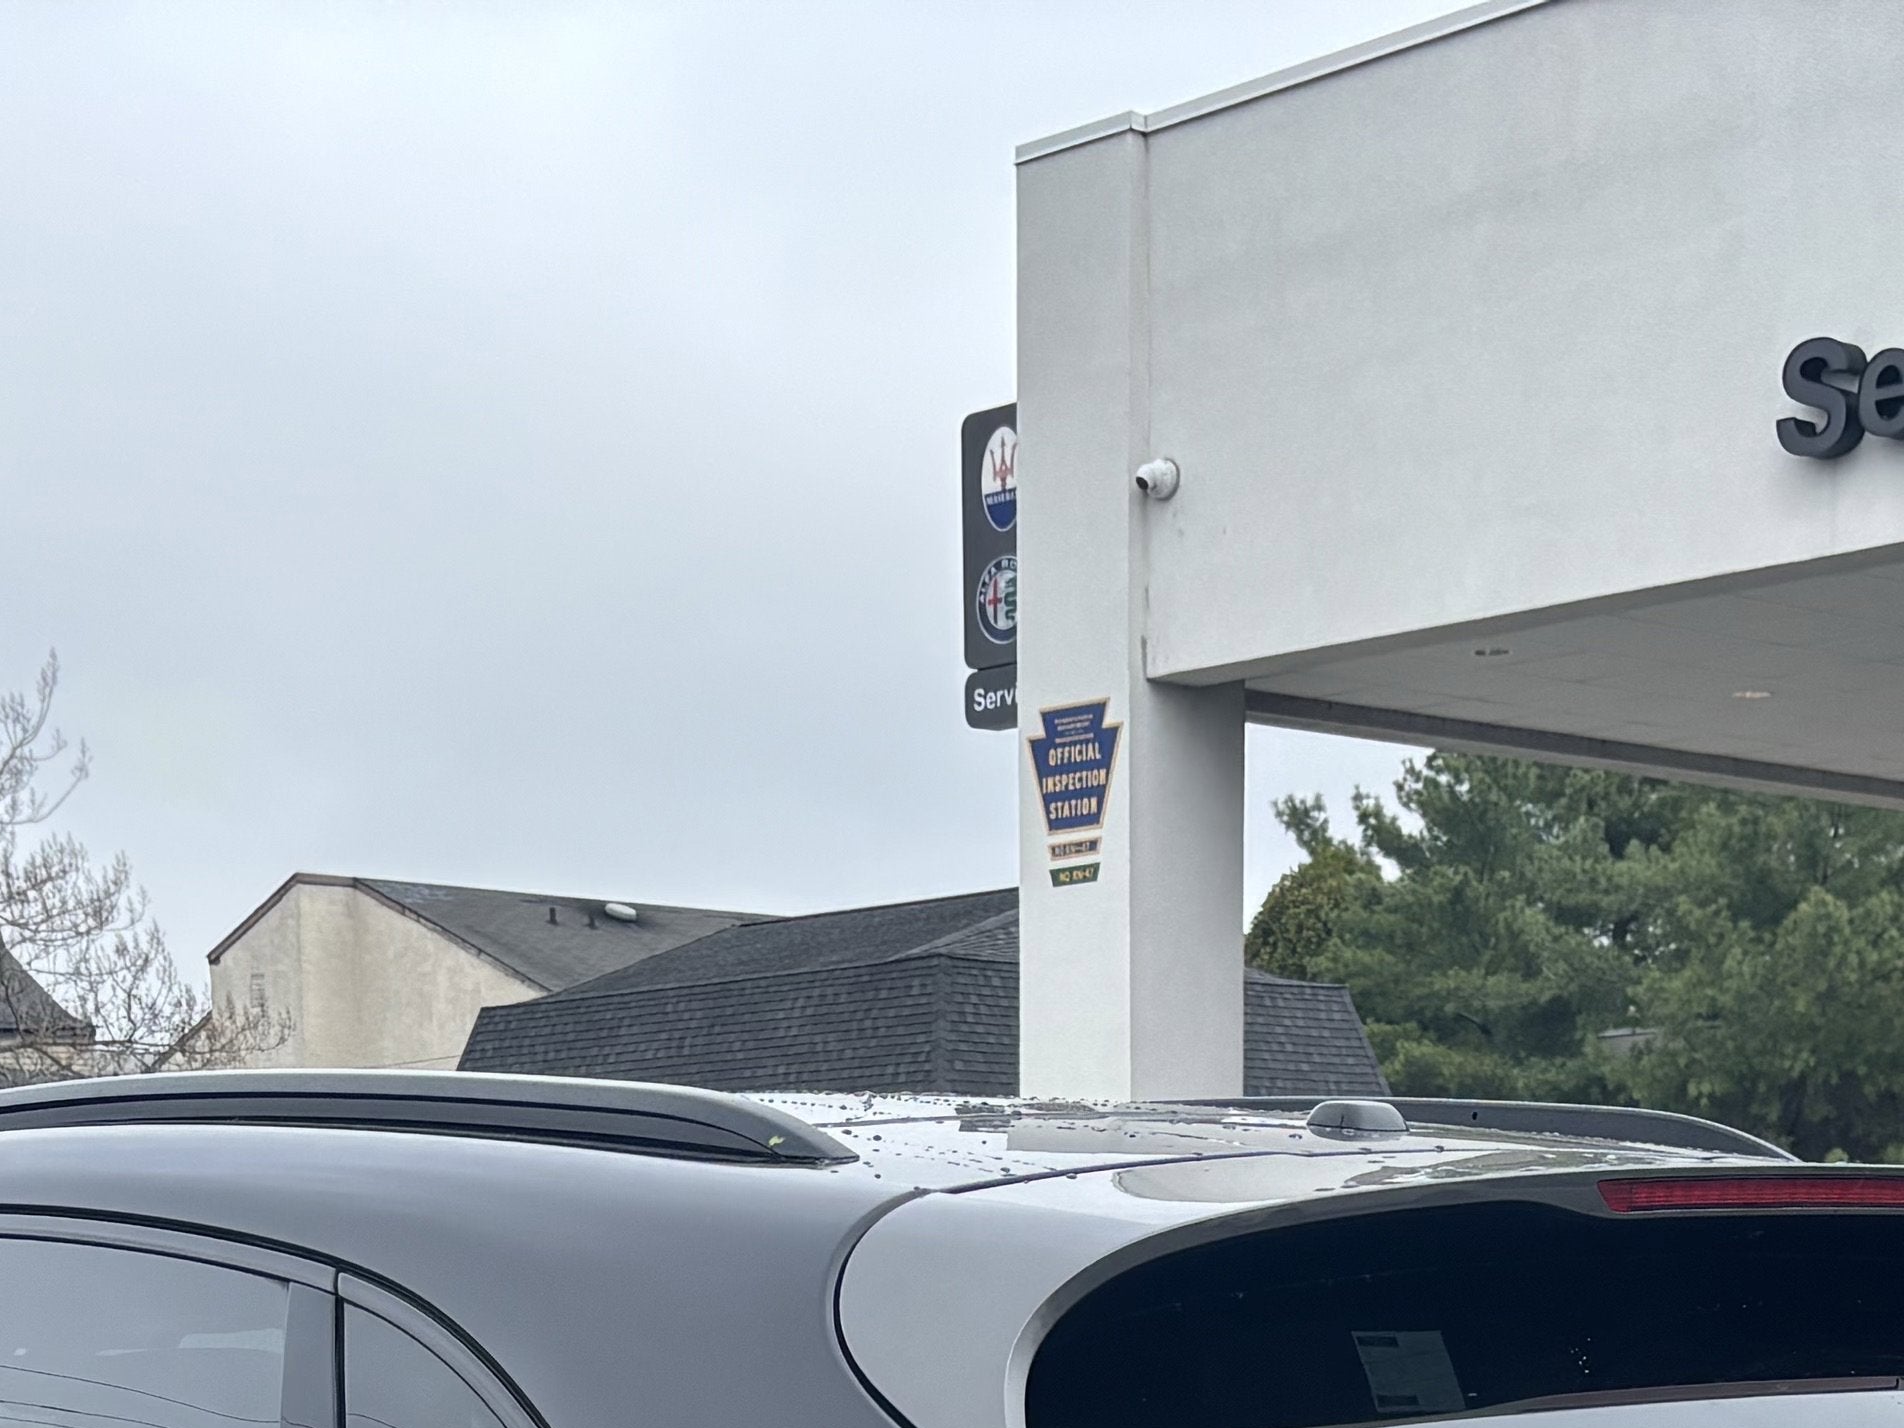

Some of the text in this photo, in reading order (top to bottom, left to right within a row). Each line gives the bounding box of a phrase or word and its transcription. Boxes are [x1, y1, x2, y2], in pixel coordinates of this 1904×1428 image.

[1048, 742, 1102, 766] OFFICIAL
[1042, 768, 1107, 794] INSPECTION
[1049, 797, 1098, 819] STATION
